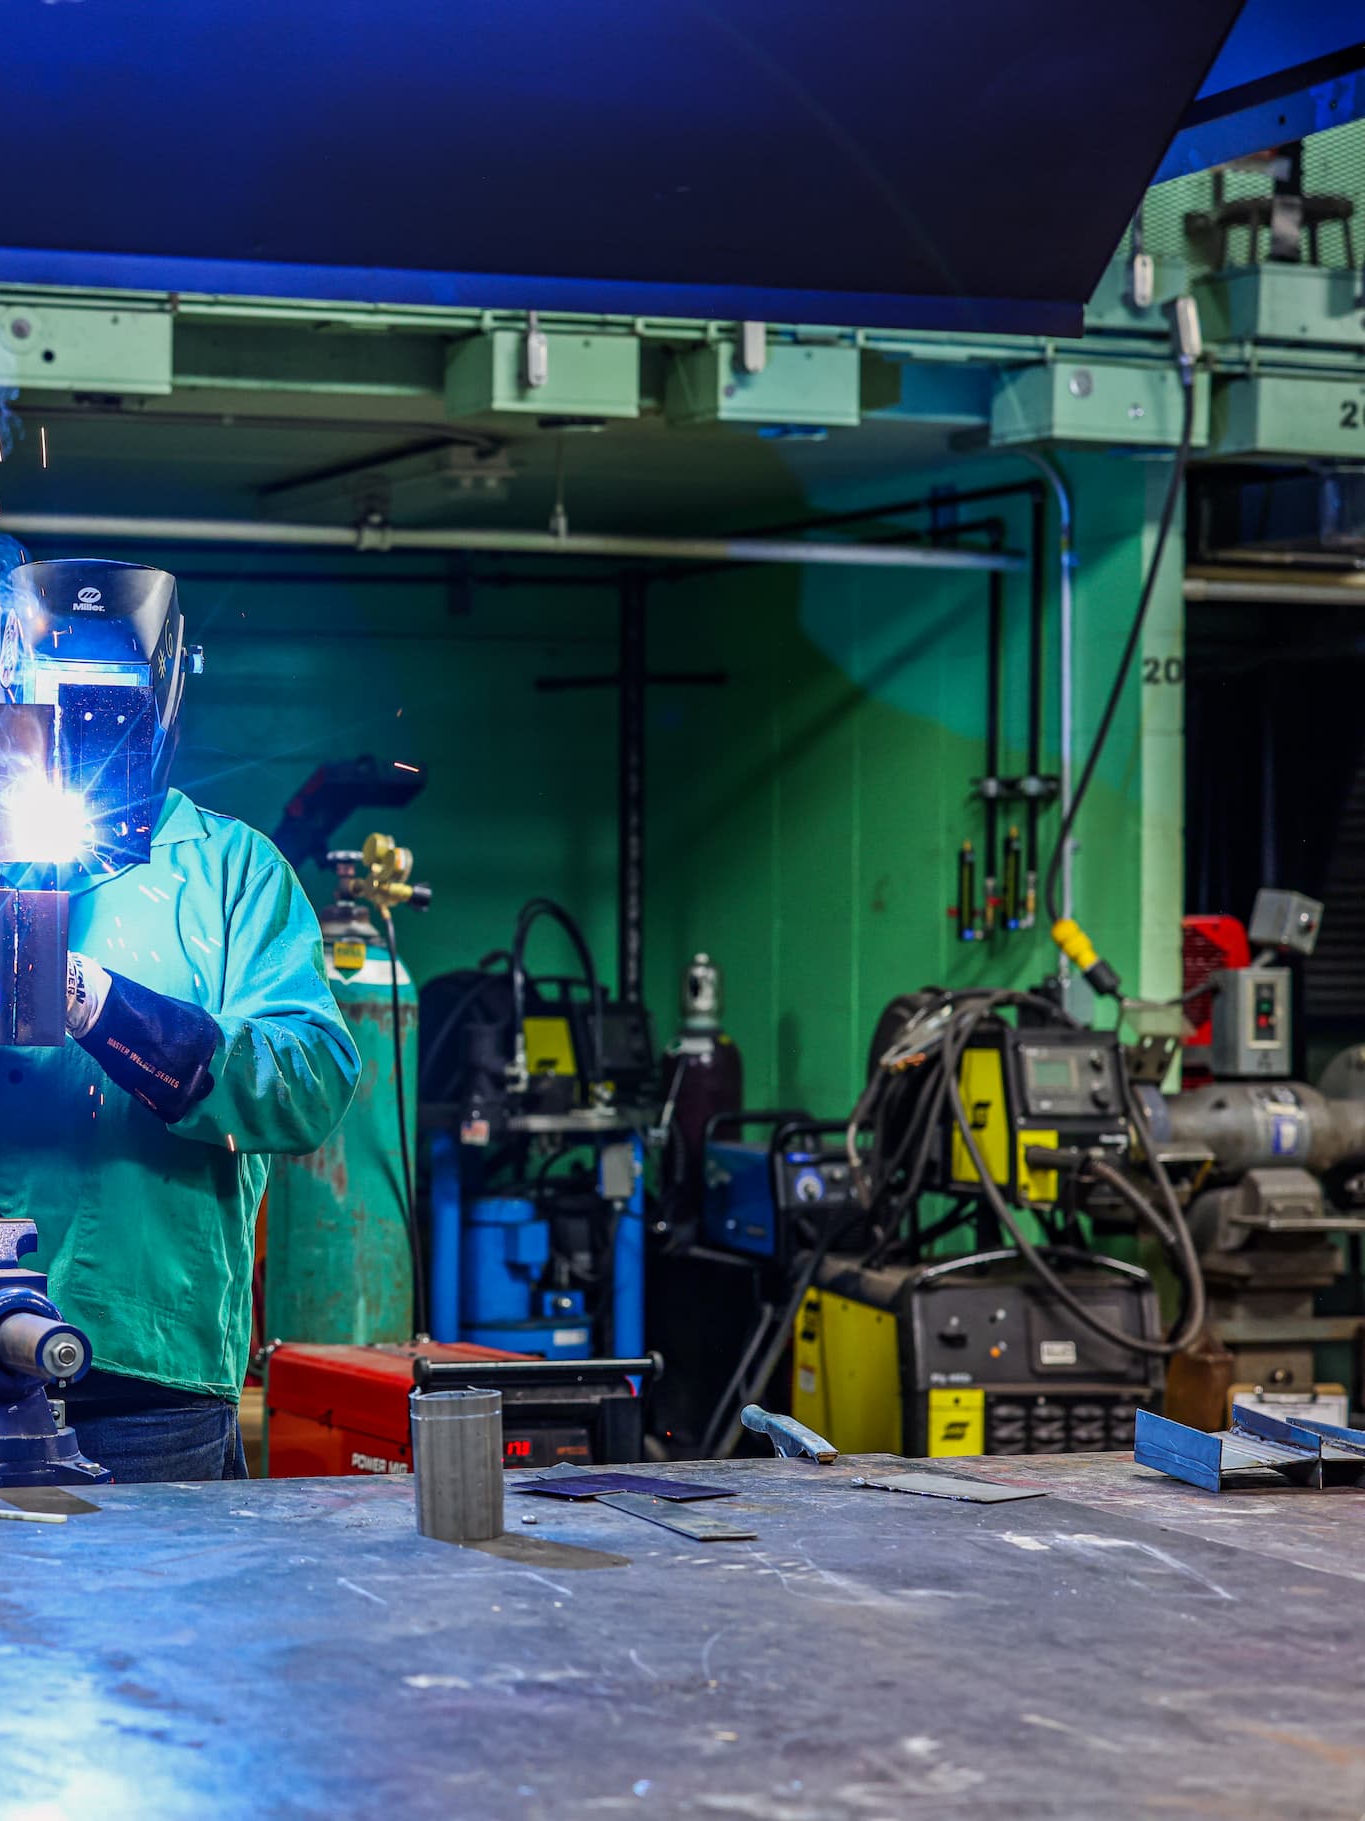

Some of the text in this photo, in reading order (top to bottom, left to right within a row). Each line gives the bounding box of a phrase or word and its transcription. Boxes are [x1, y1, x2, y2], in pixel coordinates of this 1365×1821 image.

[1339, 400, 1365, 430] 2
[1142, 658, 1184, 685] 20
[154, 1069, 181, 1090] SERIES
[351, 1452, 387, 1473] POWER
